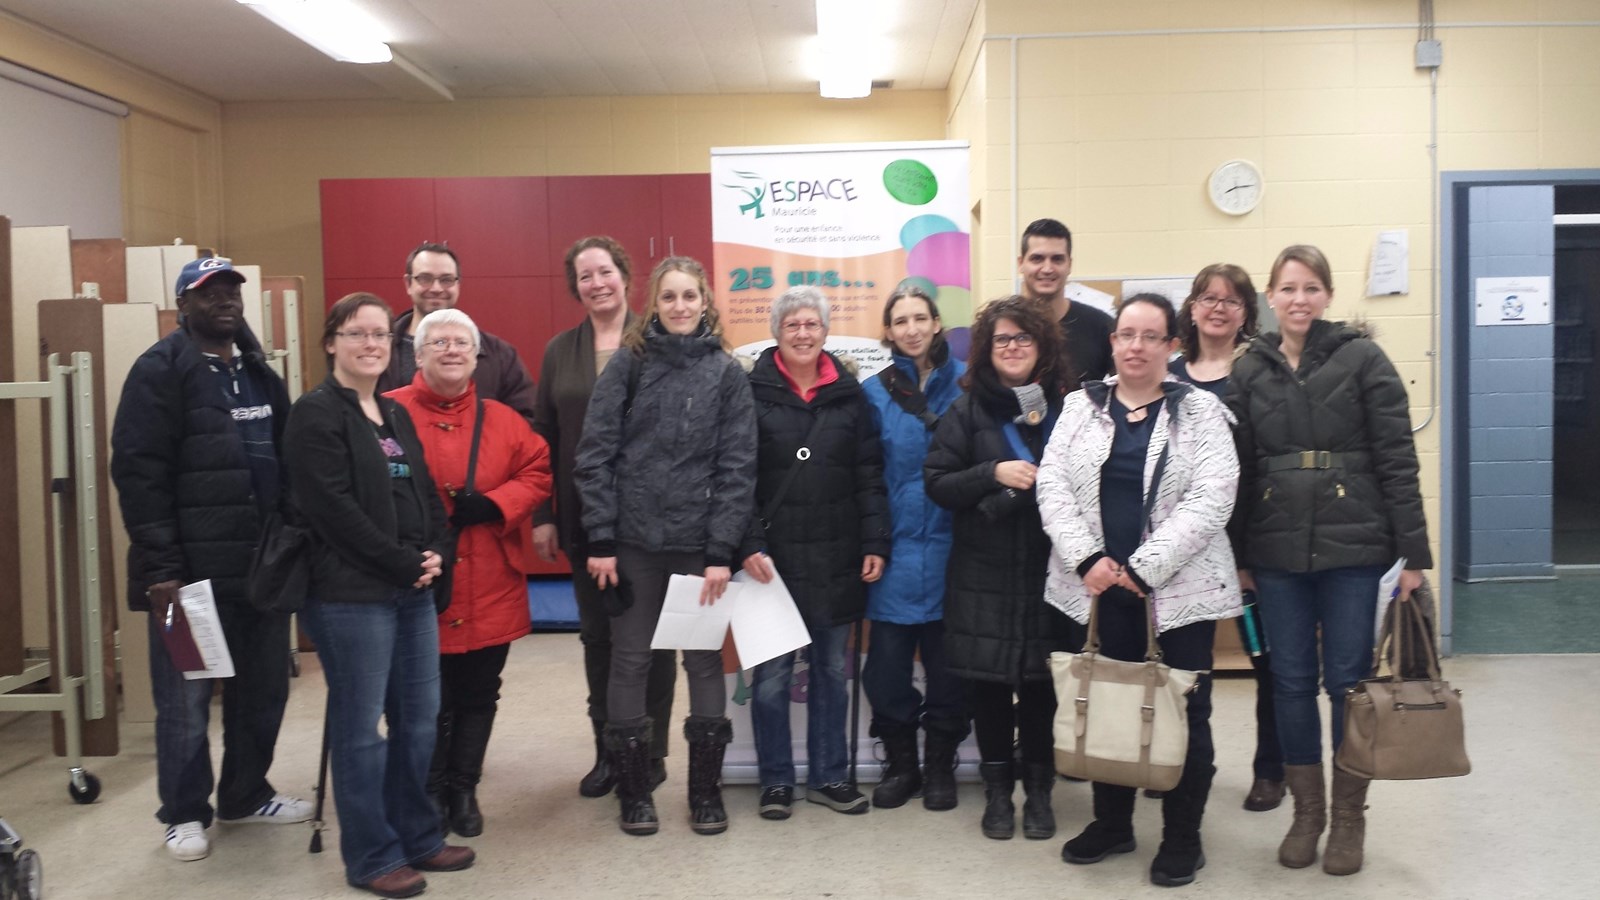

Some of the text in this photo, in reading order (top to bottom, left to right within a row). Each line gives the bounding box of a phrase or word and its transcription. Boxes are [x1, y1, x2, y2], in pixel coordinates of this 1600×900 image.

[769, 178, 858, 202] ESPACE
[771, 206, 817, 216] Mauricie
[729, 266, 775, 291] 25
